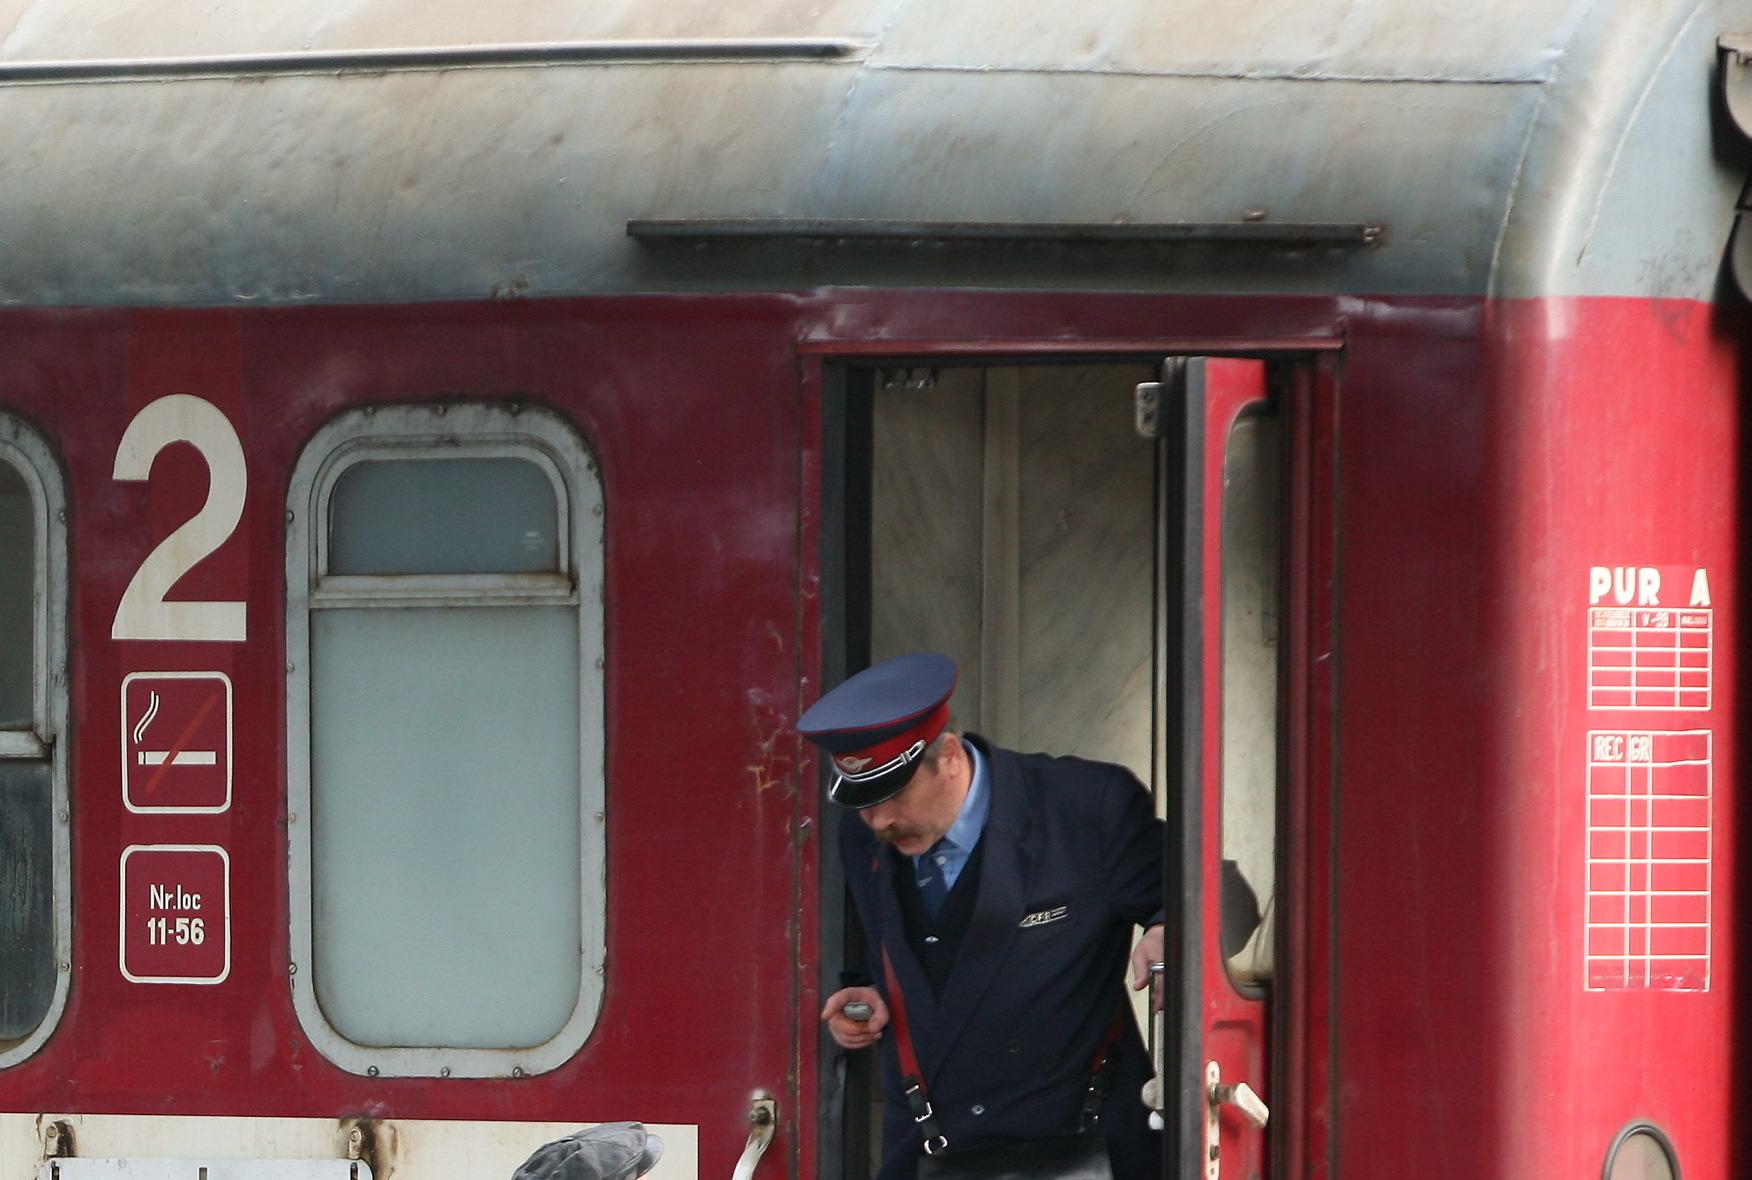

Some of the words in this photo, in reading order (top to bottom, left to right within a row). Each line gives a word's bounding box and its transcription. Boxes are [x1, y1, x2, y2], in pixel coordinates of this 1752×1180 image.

[111, 393, 247, 641] 2
[1589, 566, 1661, 606] PUR
[1689, 567, 1711, 606] A
[150, 884, 201, 910] Nr.loc
[147, 917, 205, 945] 11-56
